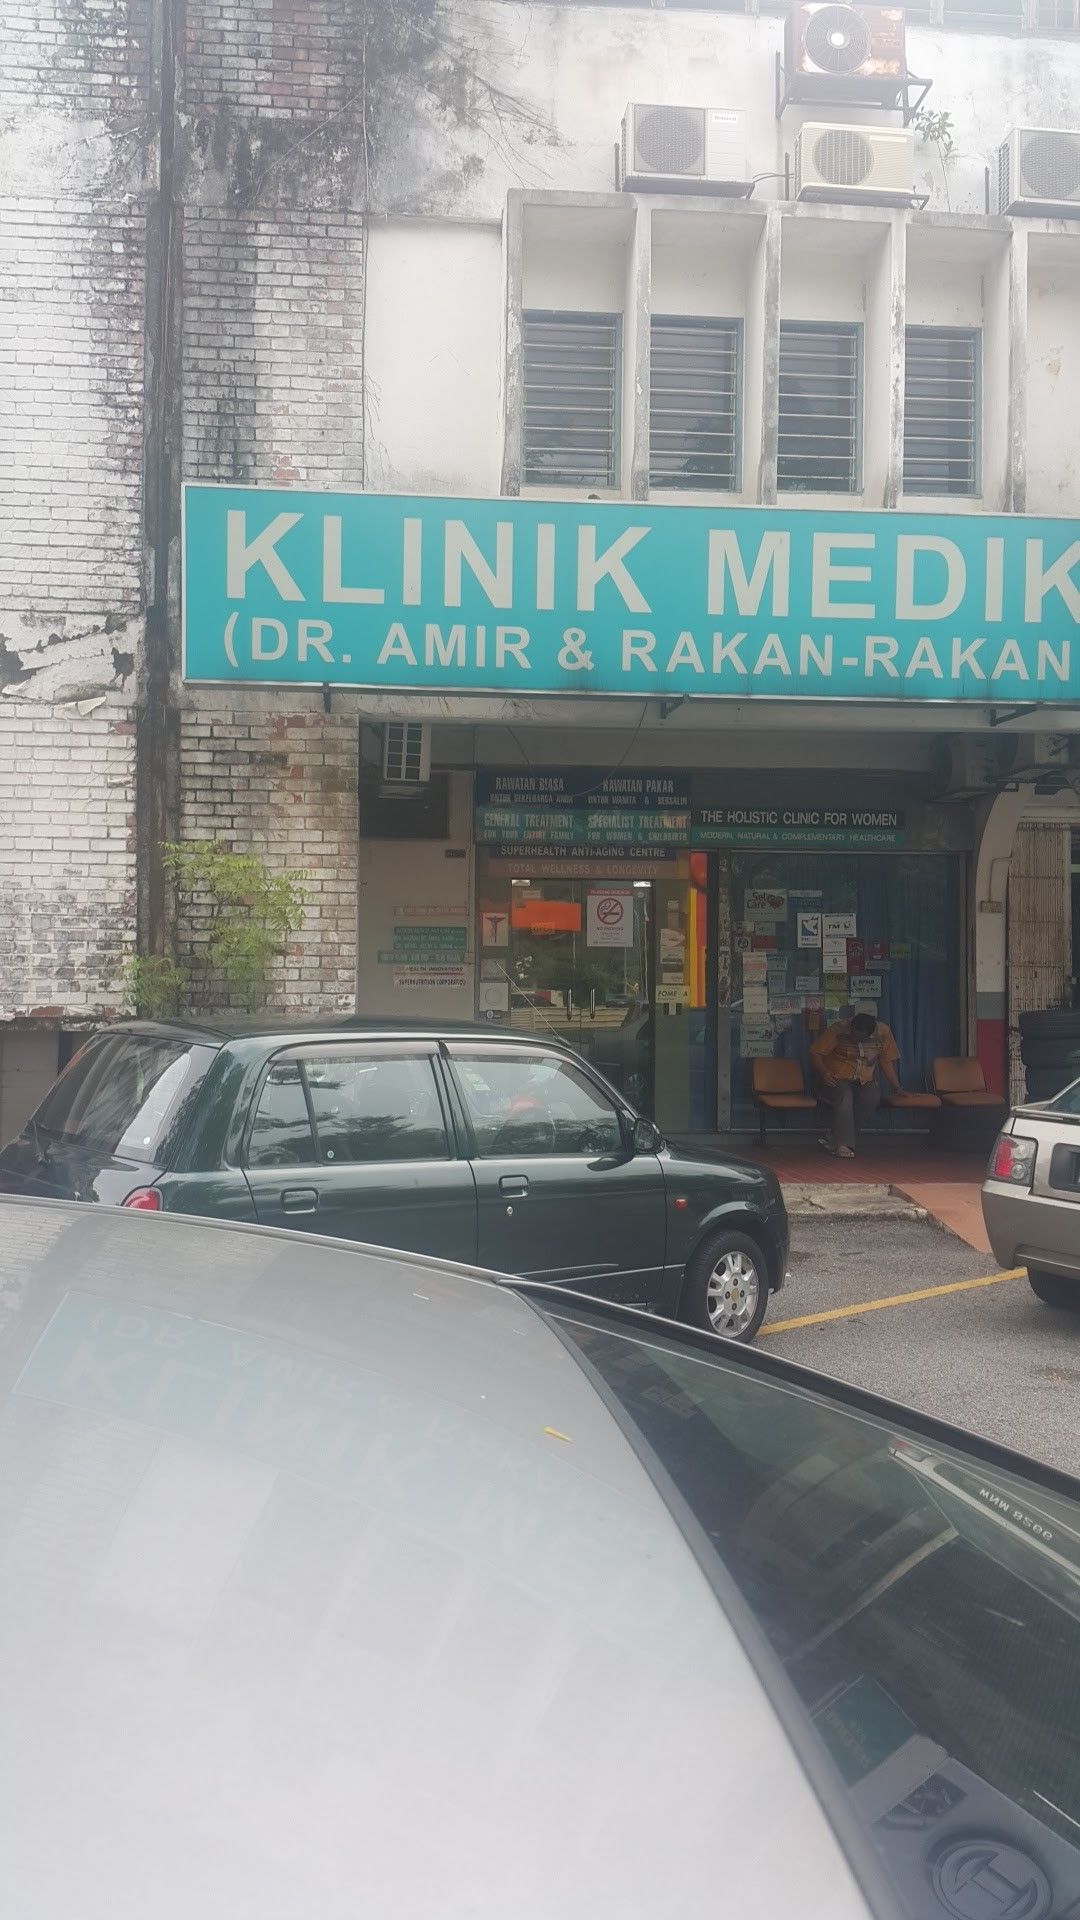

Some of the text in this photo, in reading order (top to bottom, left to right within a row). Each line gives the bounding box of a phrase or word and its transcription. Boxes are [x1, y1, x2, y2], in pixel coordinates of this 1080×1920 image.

[226, 510, 1080, 625] KLINIK MEDIK
[225, 611, 1071, 682] (DR. AMIR & RAKAN-RAKAN
[646, 780, 674, 793] PAKAR
[525, 815, 574, 828] TREATMENT
[587, 815, 687, 829] SPECIALIST TREATMENT
[701, 810, 897, 826] THE HOLISTIC CLINIC FOR WOMEN
[737, 832, 771, 840] NATURAL
[501, 845, 666, 857] SUPERHEALTH ANTI-AGING CENTRE
[507, 863, 535, 873] TOTAL
[541, 864, 590, 874] WELLNESS
[607, 865, 659, 875] LONGEVITY
